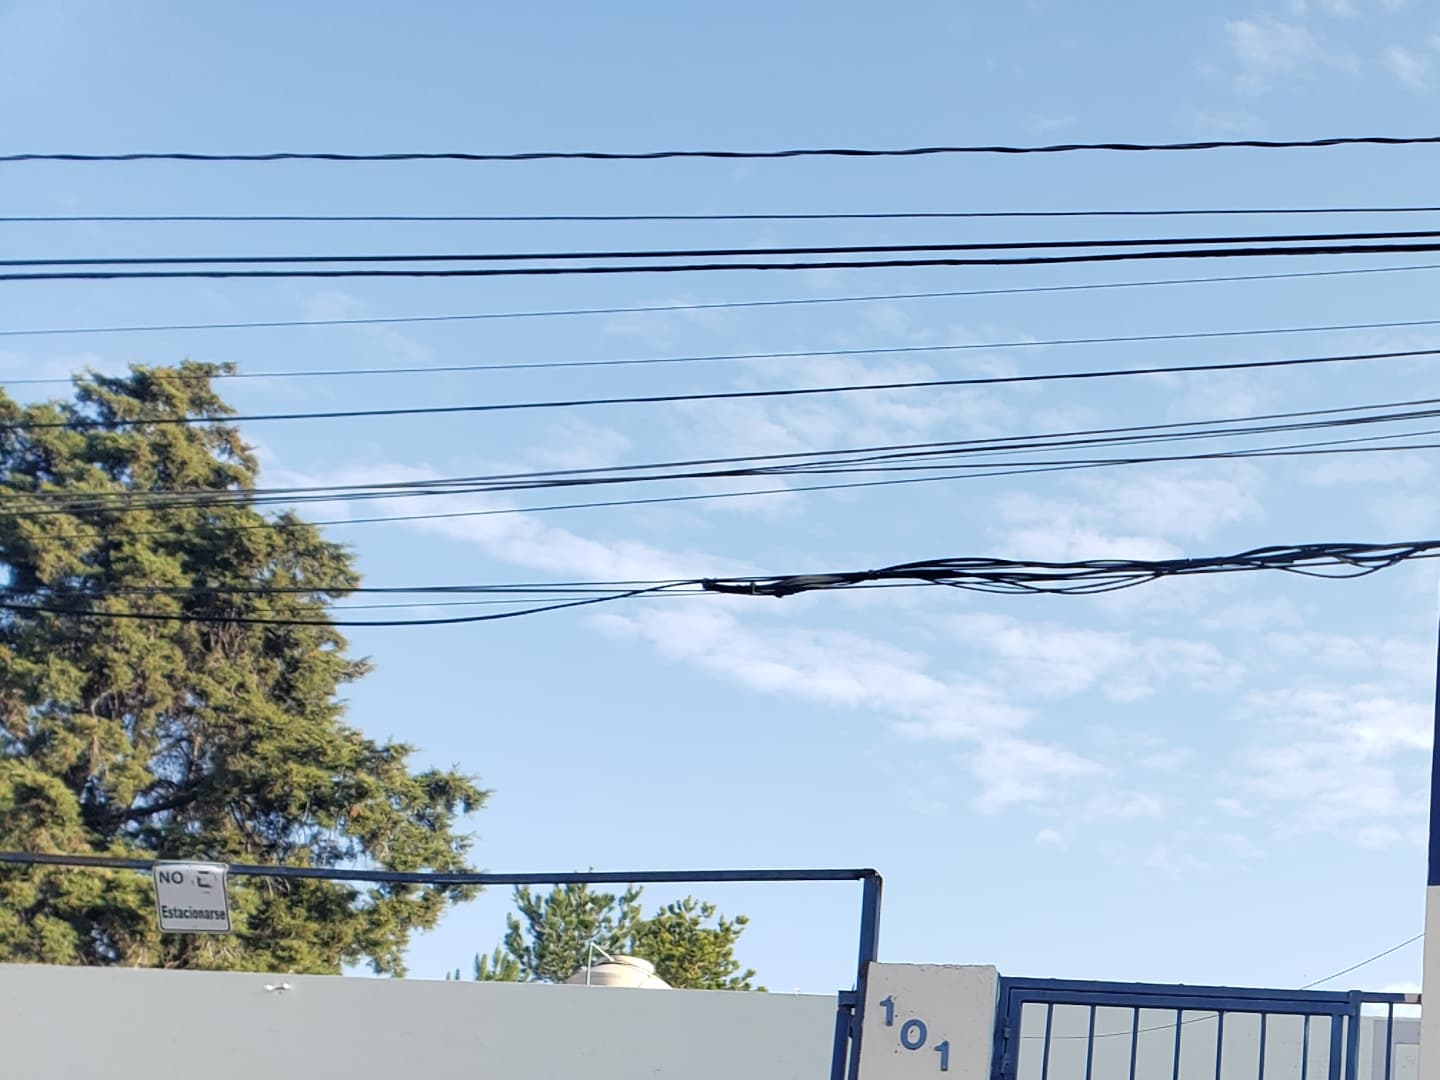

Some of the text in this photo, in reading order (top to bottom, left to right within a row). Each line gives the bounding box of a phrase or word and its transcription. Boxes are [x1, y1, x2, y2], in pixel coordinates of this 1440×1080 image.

[159, 871, 184, 884] NO
[161, 905, 226, 920] Estacionarse
[879, 994, 950, 1072] 101
